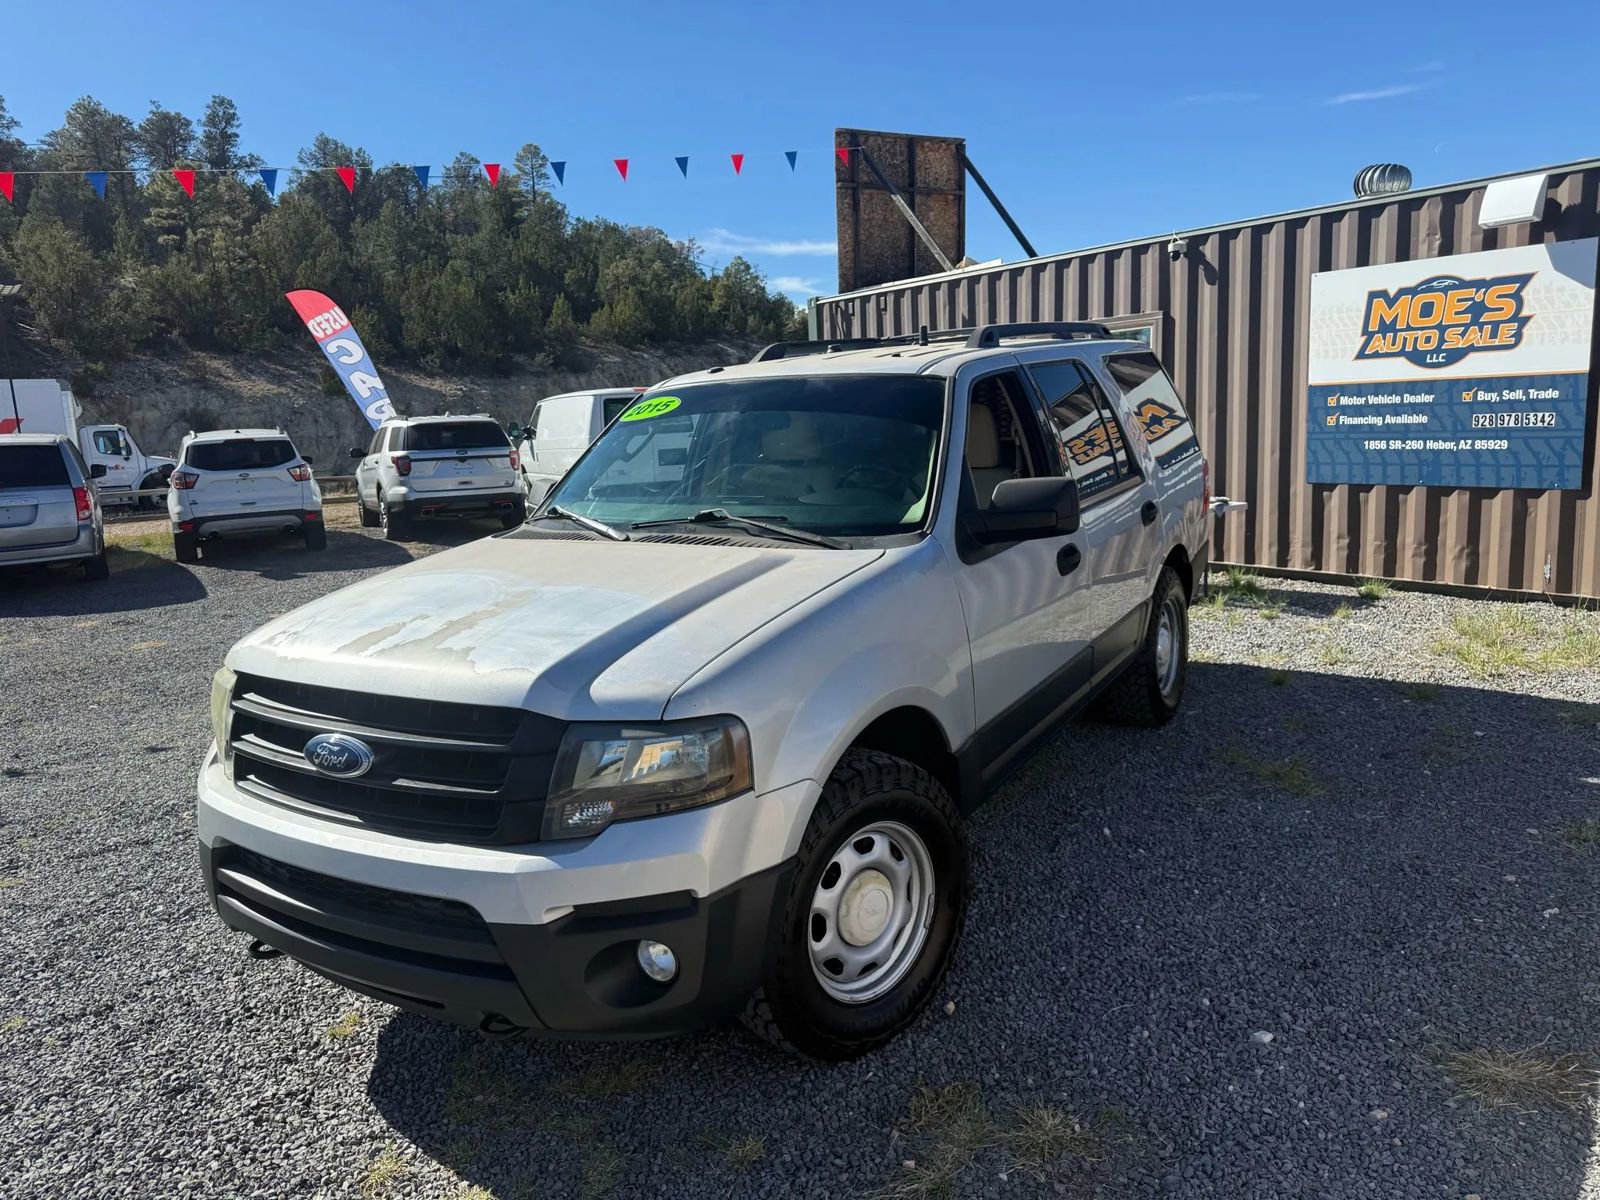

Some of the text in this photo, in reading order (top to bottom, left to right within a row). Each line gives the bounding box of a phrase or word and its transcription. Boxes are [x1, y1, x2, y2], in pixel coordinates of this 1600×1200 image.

[1368, 283, 1520, 332] MOE'S
[1365, 323, 1519, 354] AUTO SALE
[1426, 352, 1446, 363] LLC
[1339, 393, 1435, 406] Motor Vehicle Dealer
[1477, 388, 1560, 403] Buy, Sell, Trade
[623, 399, 677, 419] 2015
[1339, 414, 1428, 426] Financing Available
[1473, 413, 1555, 427] 928 978 5342
[1363, 440, 1508, 452] 1856 SR-260 Heber, AZ 85929
[312, 742, 348, 768] Ford
